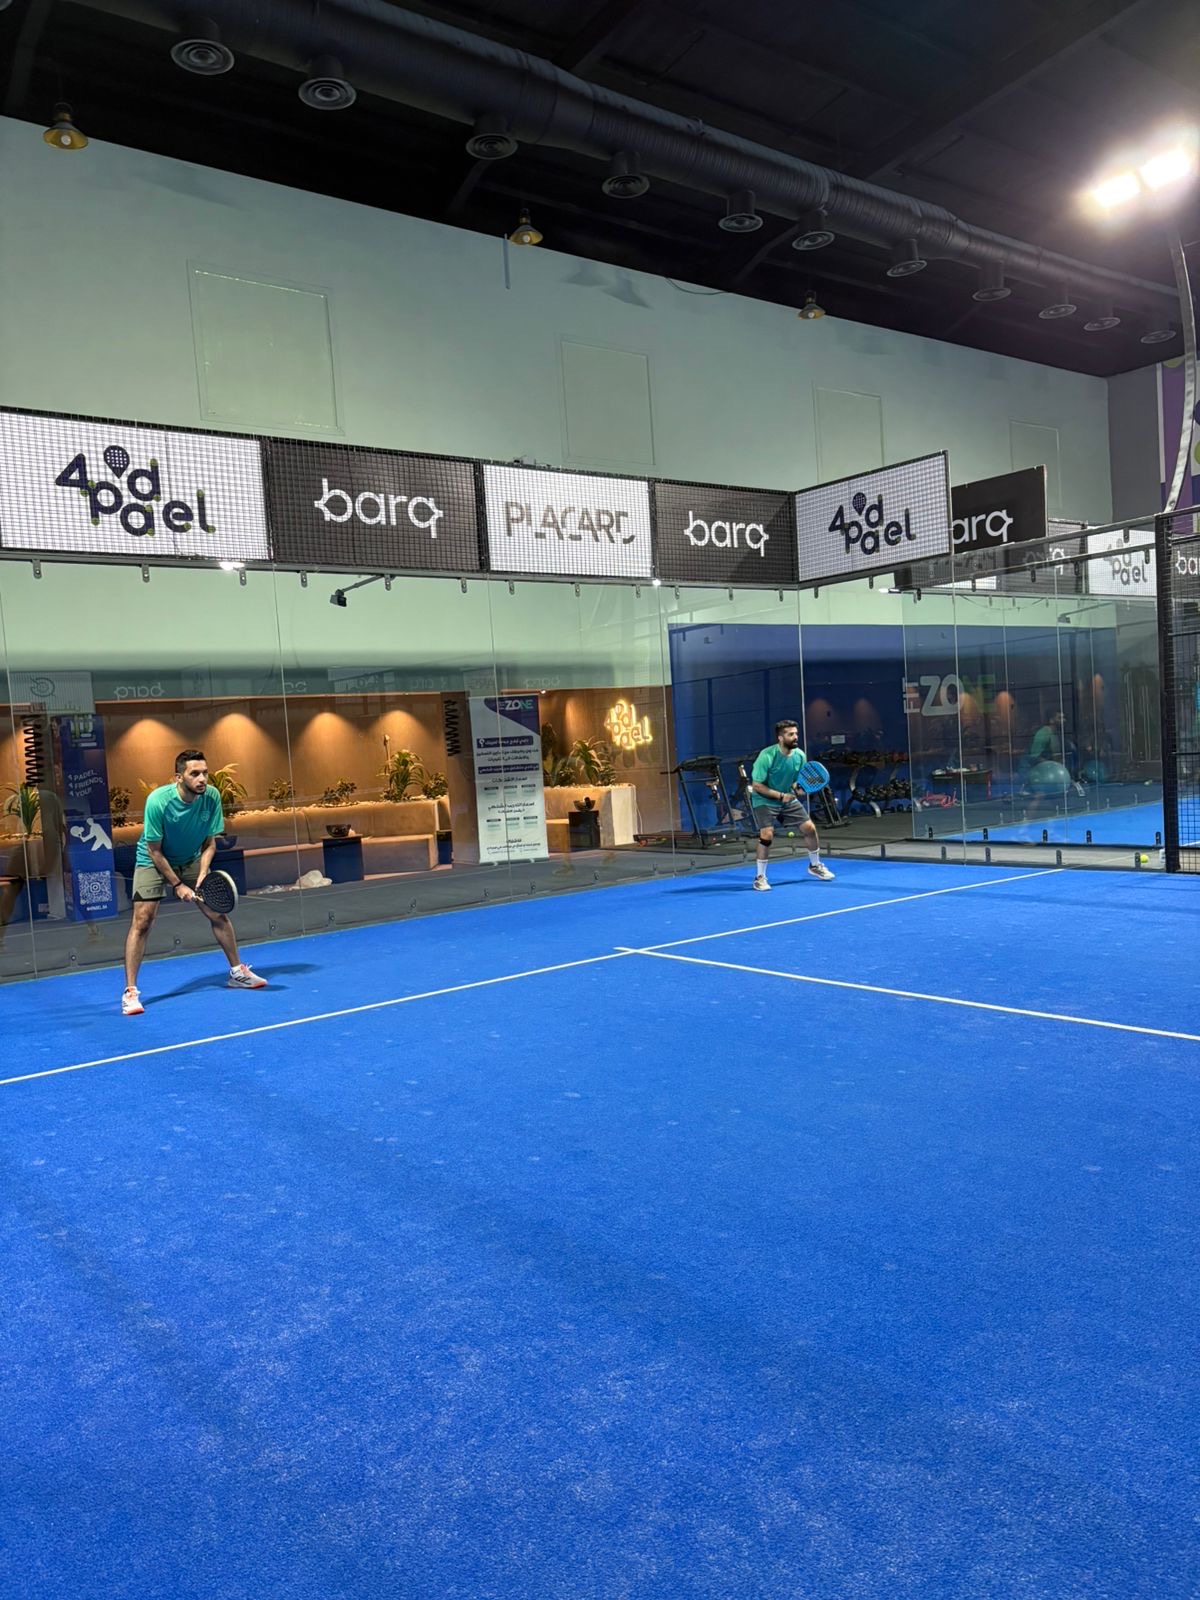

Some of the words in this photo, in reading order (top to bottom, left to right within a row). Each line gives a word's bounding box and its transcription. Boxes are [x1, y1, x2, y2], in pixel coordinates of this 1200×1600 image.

[314, 478, 444, 539] barq
[684, 511, 770, 557] barq
[952, 509, 1014, 545] arq
[1175, 550, 1200, 575] ba
[505, 699, 534, 711] ZONE
